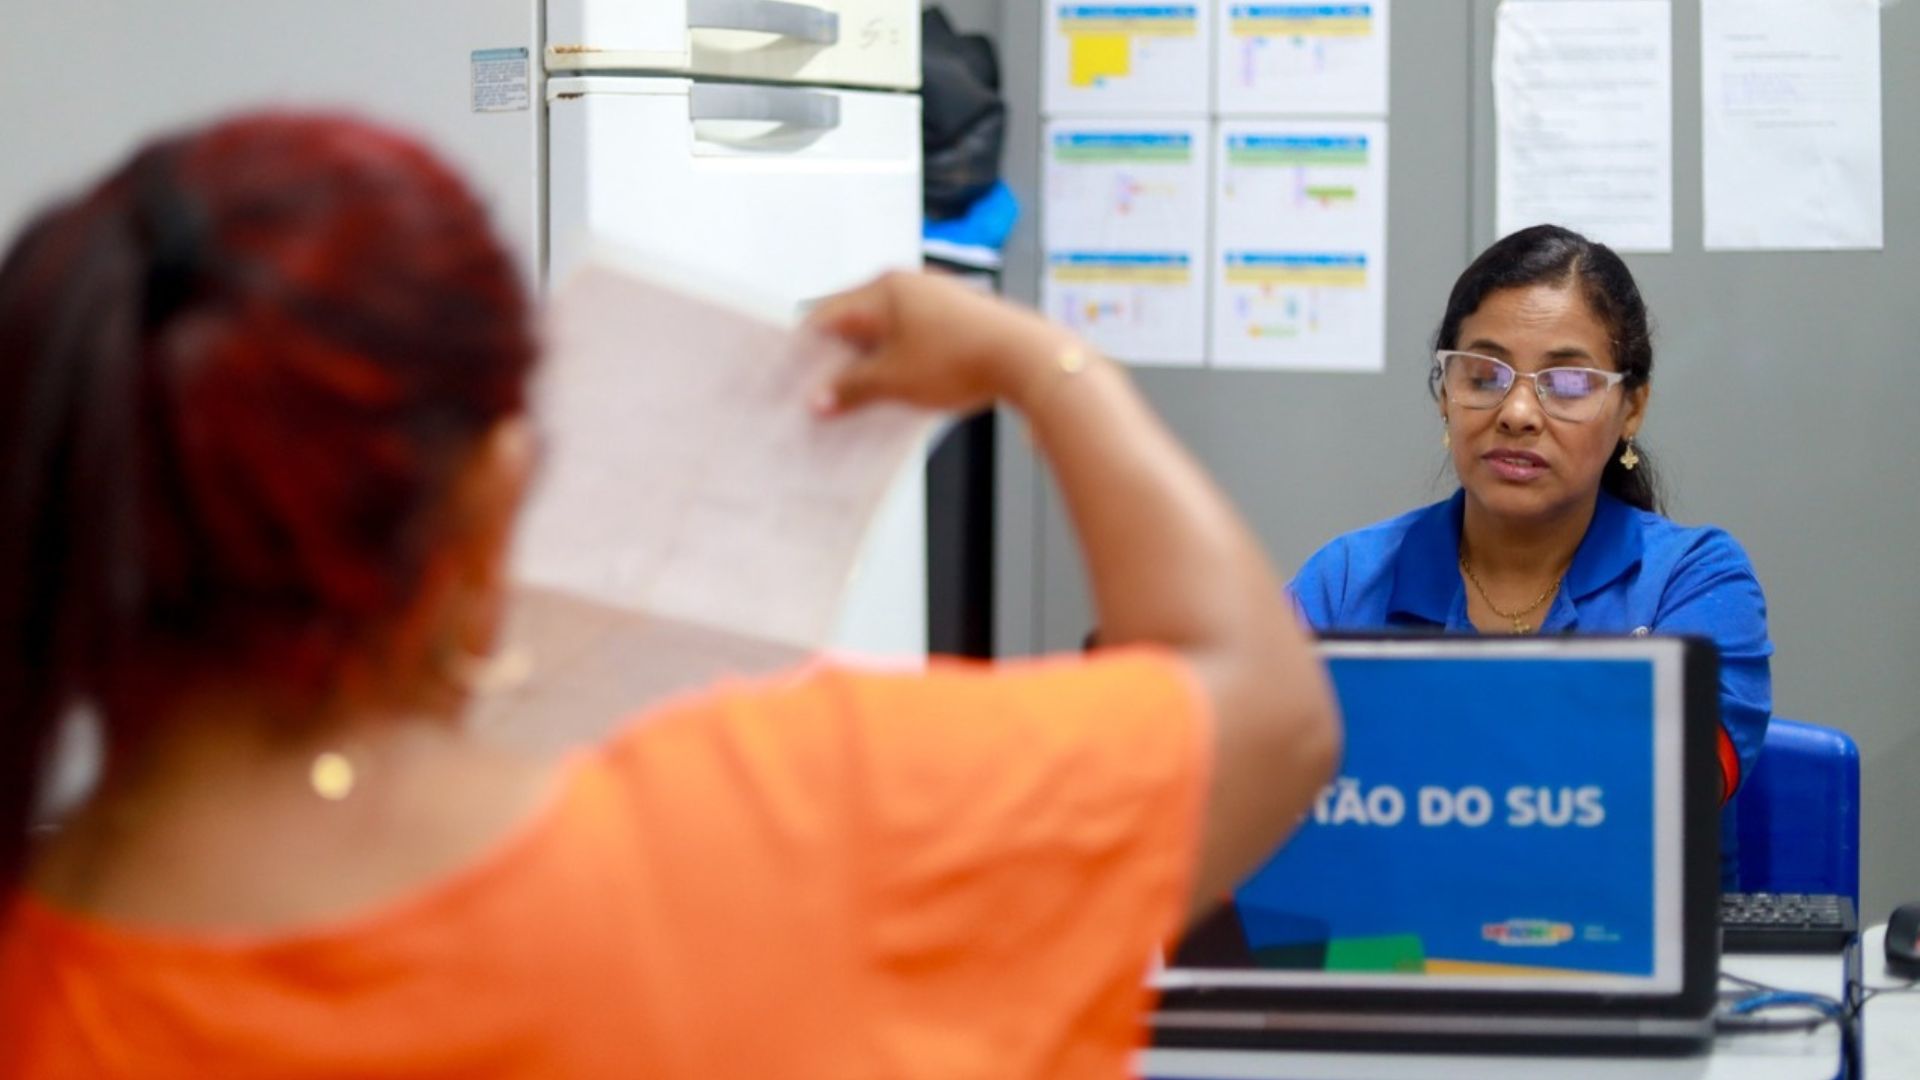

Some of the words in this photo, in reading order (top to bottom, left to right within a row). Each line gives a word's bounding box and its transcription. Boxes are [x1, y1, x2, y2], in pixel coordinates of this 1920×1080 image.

[1299, 776, 1406, 827] TÃO
[1418, 785, 1493, 827] DO
[1505, 785, 1605, 827] SUS
